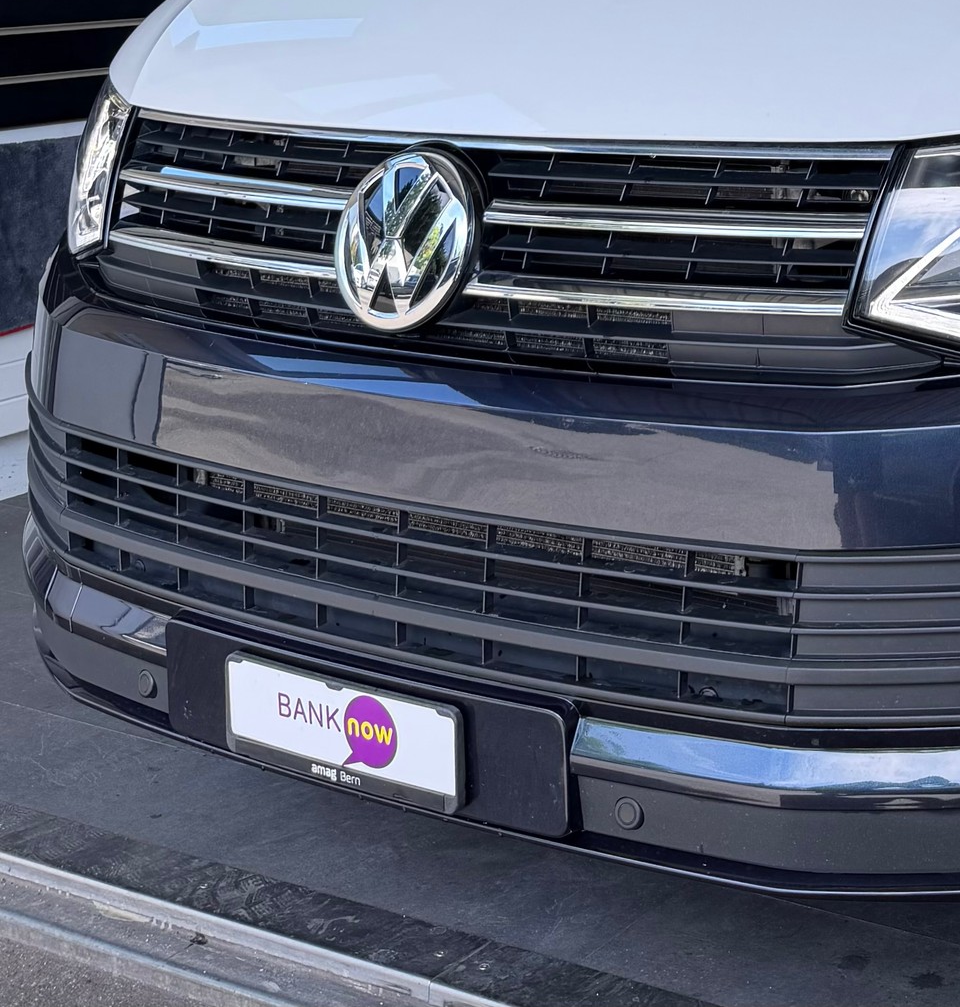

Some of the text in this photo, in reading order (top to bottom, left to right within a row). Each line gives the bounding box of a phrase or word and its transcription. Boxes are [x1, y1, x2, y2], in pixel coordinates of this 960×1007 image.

[278, 692, 393, 746] BANK now
[311, 763, 361, 786] amag Bern
